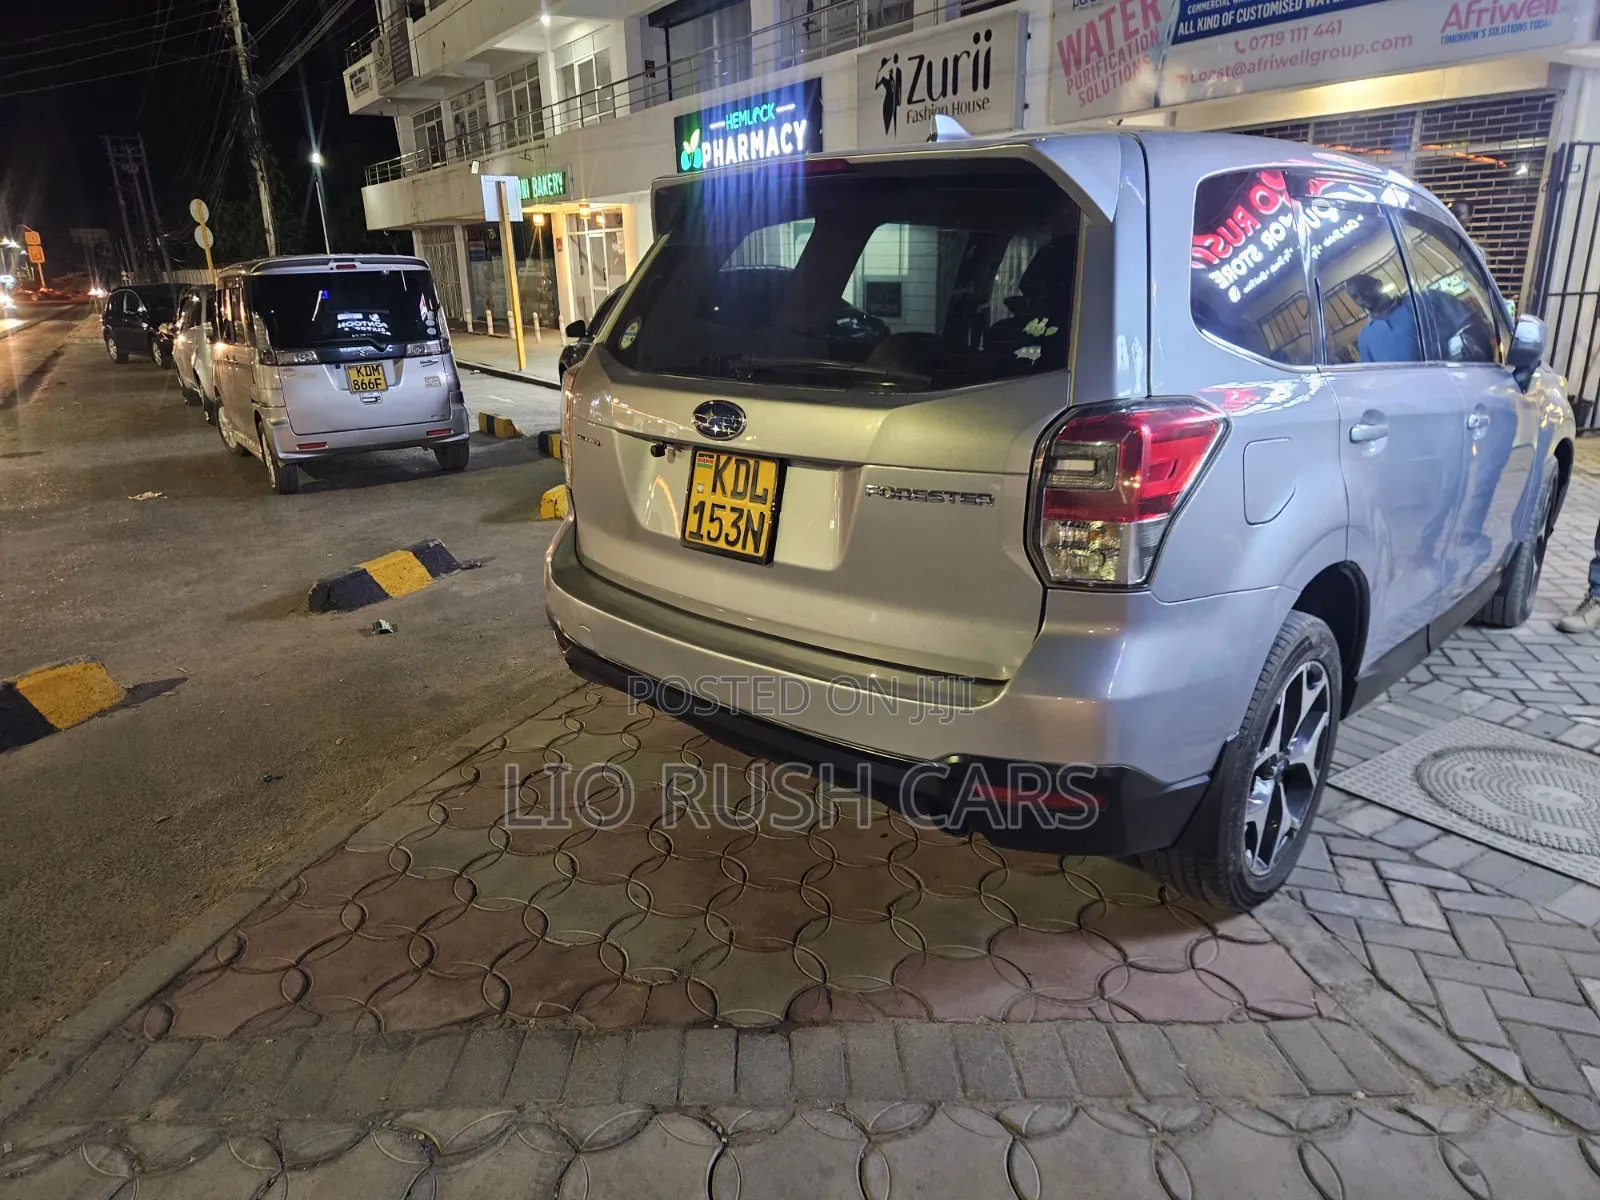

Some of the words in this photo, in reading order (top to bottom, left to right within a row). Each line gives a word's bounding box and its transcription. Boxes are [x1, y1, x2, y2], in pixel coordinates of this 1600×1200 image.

[1177, 20, 1195, 36] ALL
[1197, 13, 1220, 32] KIND
[1221, 10, 1235, 27] OF
[1236, 0, 1303, 24] CUSTOMISED
[1249, 30, 1285, 51] 0719
[1290, 26, 1309, 44] 111
[1313, 19, 1343, 37] 441
[1440, 0, 1559, 34] Afriwell
[1487, 21, 1528, 38] SOLUTIONS
[1057, 0, 1163, 78] WATER
[906, 28, 993, 106] Zurii
[1066, 26, 1160, 96] PURIFICATION
[1190, 34, 1413, 84] coast@afriwellgroup.com
[1078, 53, 1150, 108] SOLUTIONS
[725, 102, 776, 131] HEMLOCK
[906, 103, 949, 125] Fashion
[951, 96, 990, 116] House
[701, 118, 808, 169] PHARMACY
[352, 377, 382, 391] 866F
[356, 364, 381, 378] KDM
[711, 454, 769, 505] KDL
[865, 484, 996, 507] FORESTER
[688, 500, 766, 554] 153N
